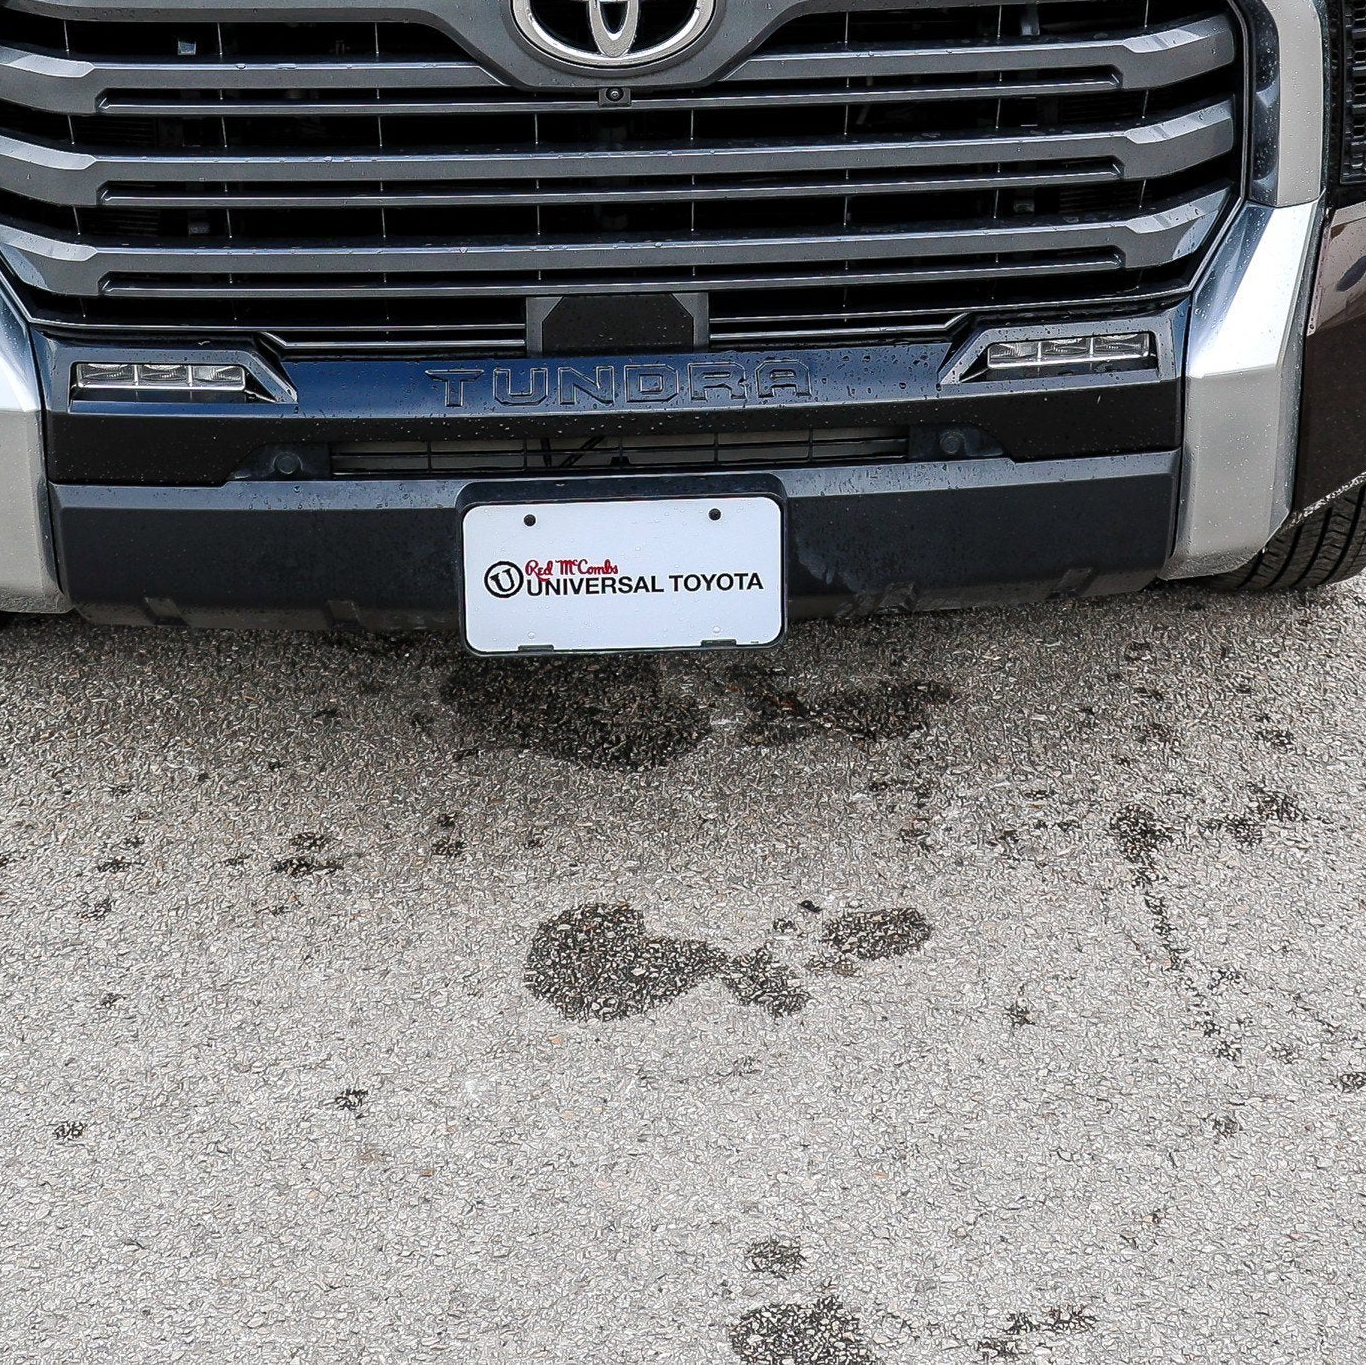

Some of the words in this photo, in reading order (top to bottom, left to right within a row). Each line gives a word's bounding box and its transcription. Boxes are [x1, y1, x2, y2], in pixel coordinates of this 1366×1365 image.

[425, 359, 813, 408] TUNDRA
[525, 559, 554, 582] Red
[555, 558, 619, 576] McCombs
[526, 574, 665, 597] UNIVERSAL
[669, 572, 765, 592] TOYOTA
